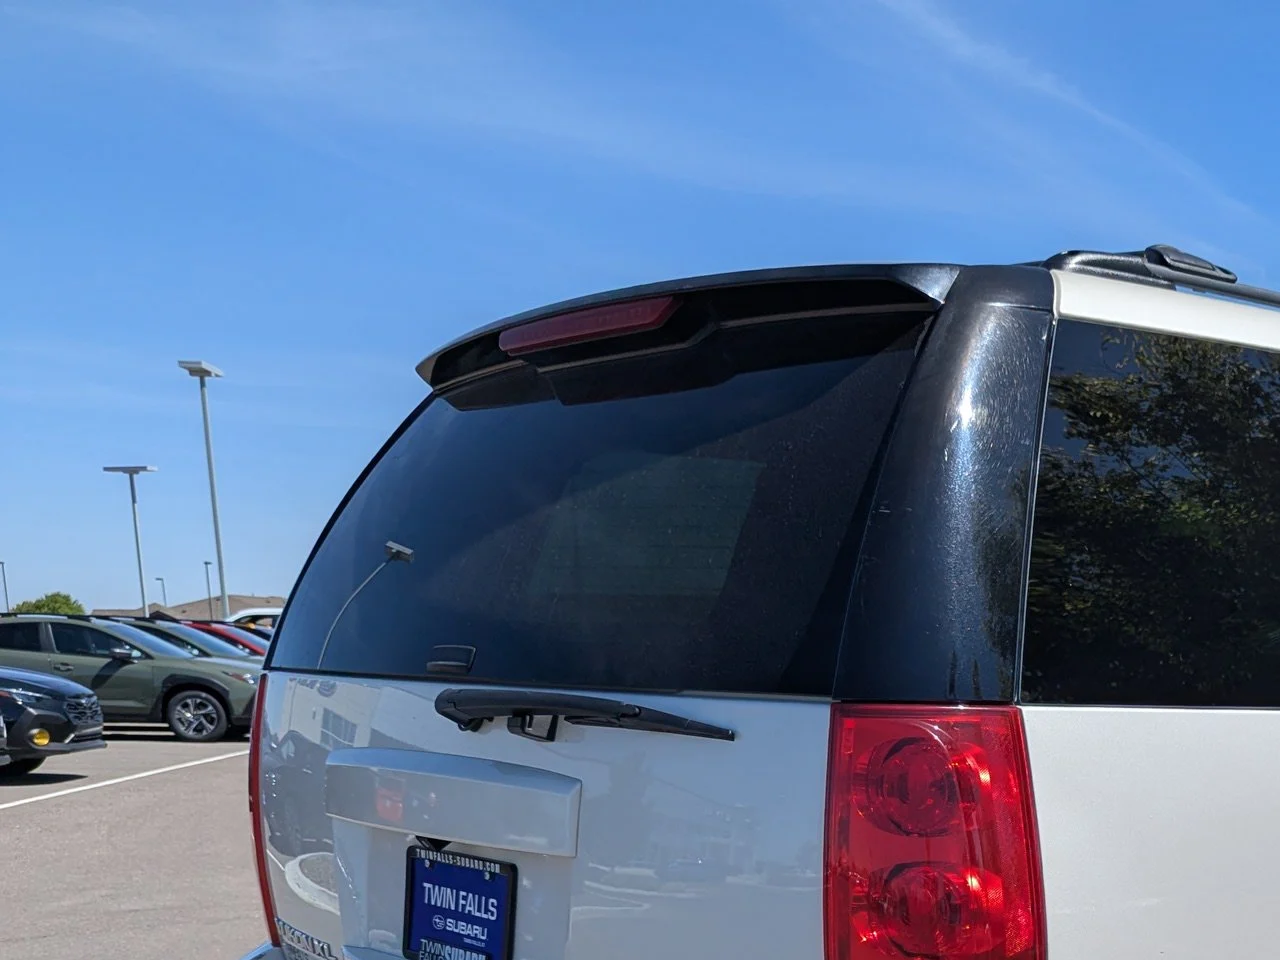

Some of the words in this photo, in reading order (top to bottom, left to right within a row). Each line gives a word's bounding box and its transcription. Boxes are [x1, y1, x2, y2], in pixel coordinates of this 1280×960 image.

[423, 882, 456, 910] TWIN
[458, 890, 497, 920] FALLS
[445, 918, 487, 940] SUBARU
[420, 939, 446, 956] TWIN
